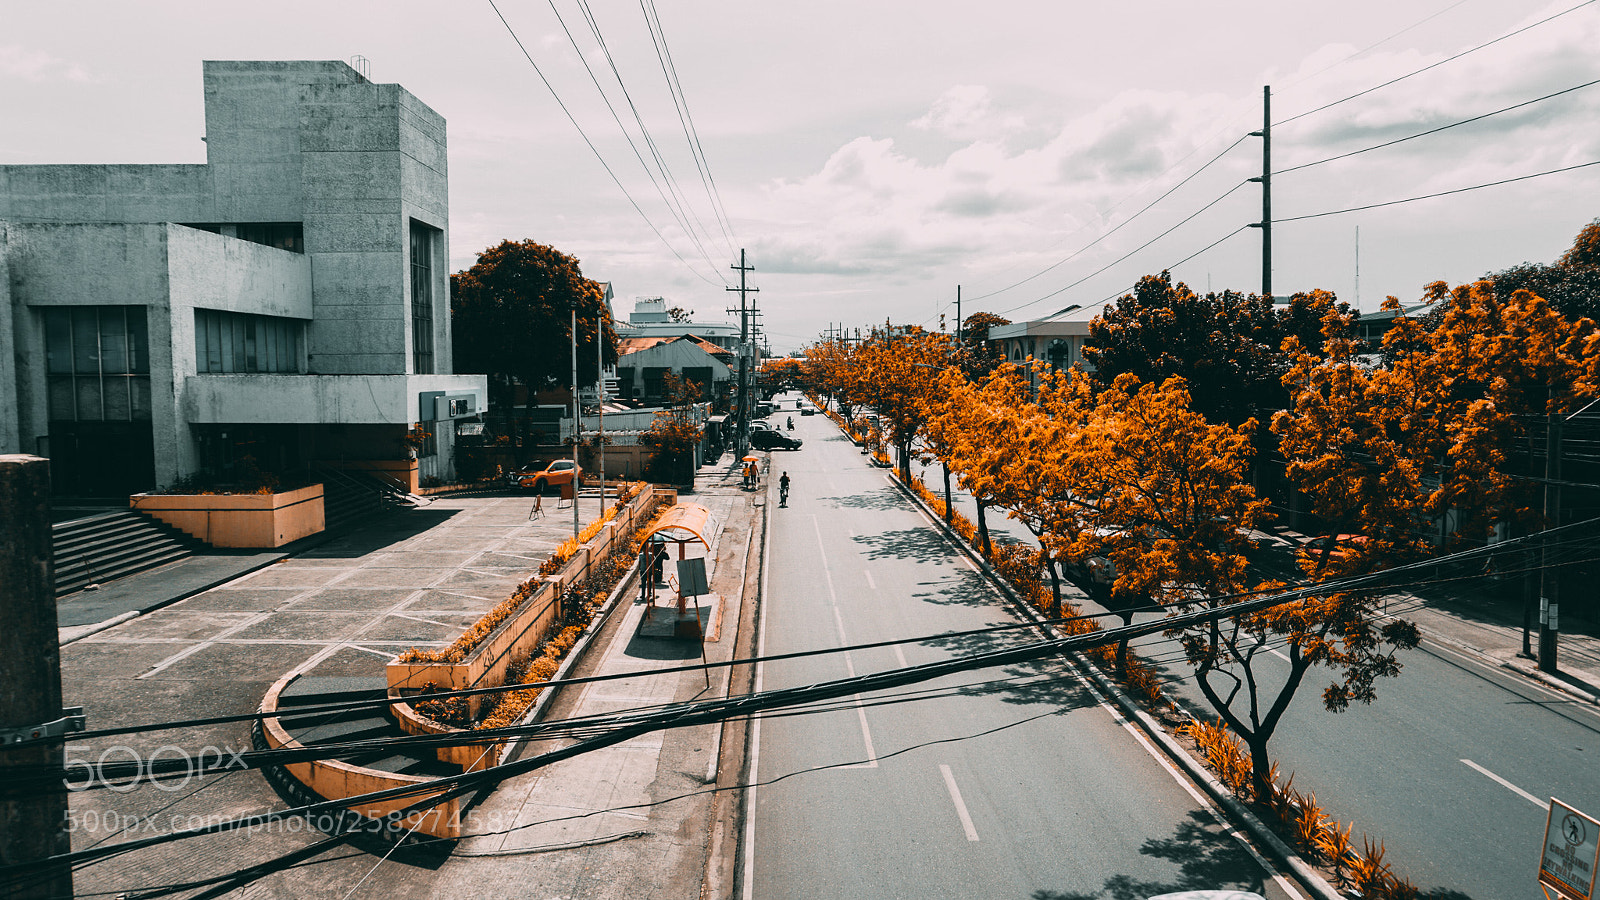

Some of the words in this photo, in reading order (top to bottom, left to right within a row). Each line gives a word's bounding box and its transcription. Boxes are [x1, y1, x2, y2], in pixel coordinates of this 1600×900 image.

[1564, 843, 1575, 855] NO
[1550, 843, 1589, 872] CROSSING
[1562, 859, 1573, 871] NO
